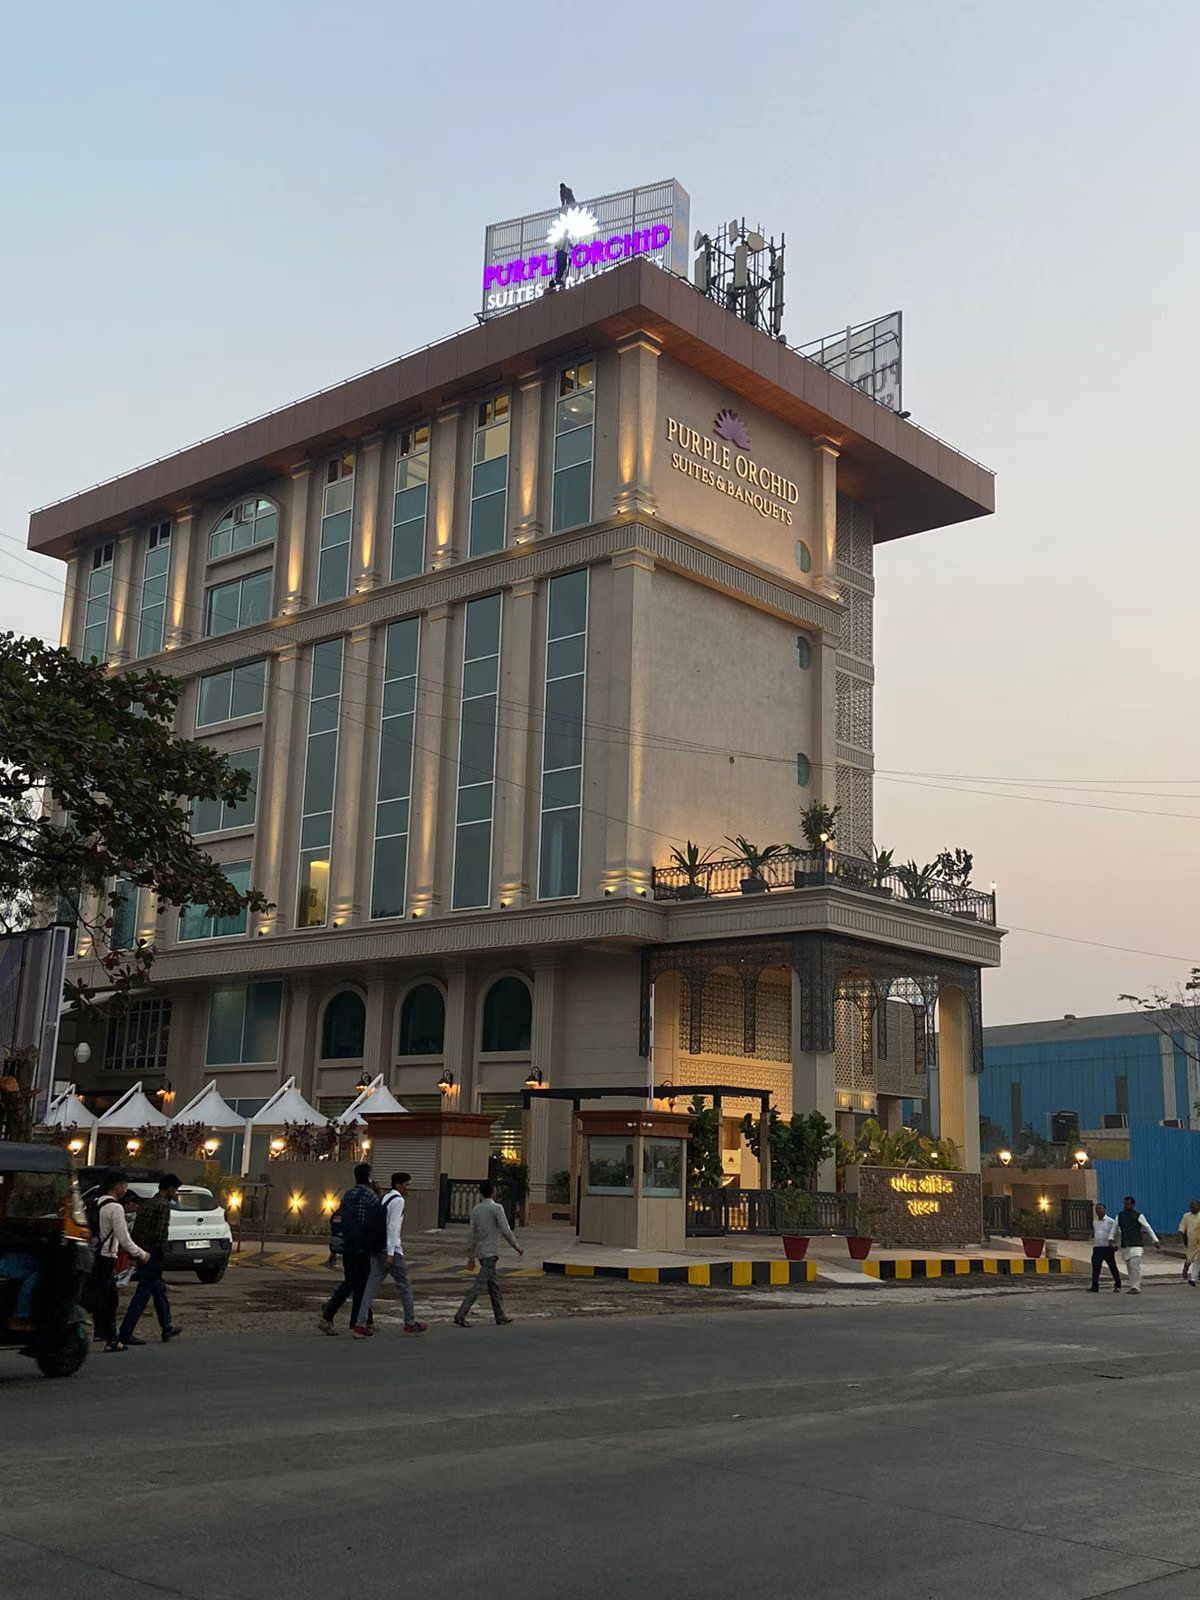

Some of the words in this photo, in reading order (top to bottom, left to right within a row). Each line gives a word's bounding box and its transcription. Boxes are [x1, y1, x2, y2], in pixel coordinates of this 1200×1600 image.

[572, 224, 671, 268] ORCHID
[487, 283, 544, 310] SUITES
[667, 417, 731, 471] PURPLE
[735, 455, 799, 505] ORCHID
[672, 453, 715, 486] SUITES
[716, 475, 726, 493] &
[727, 480, 793, 526] BANQUETS
